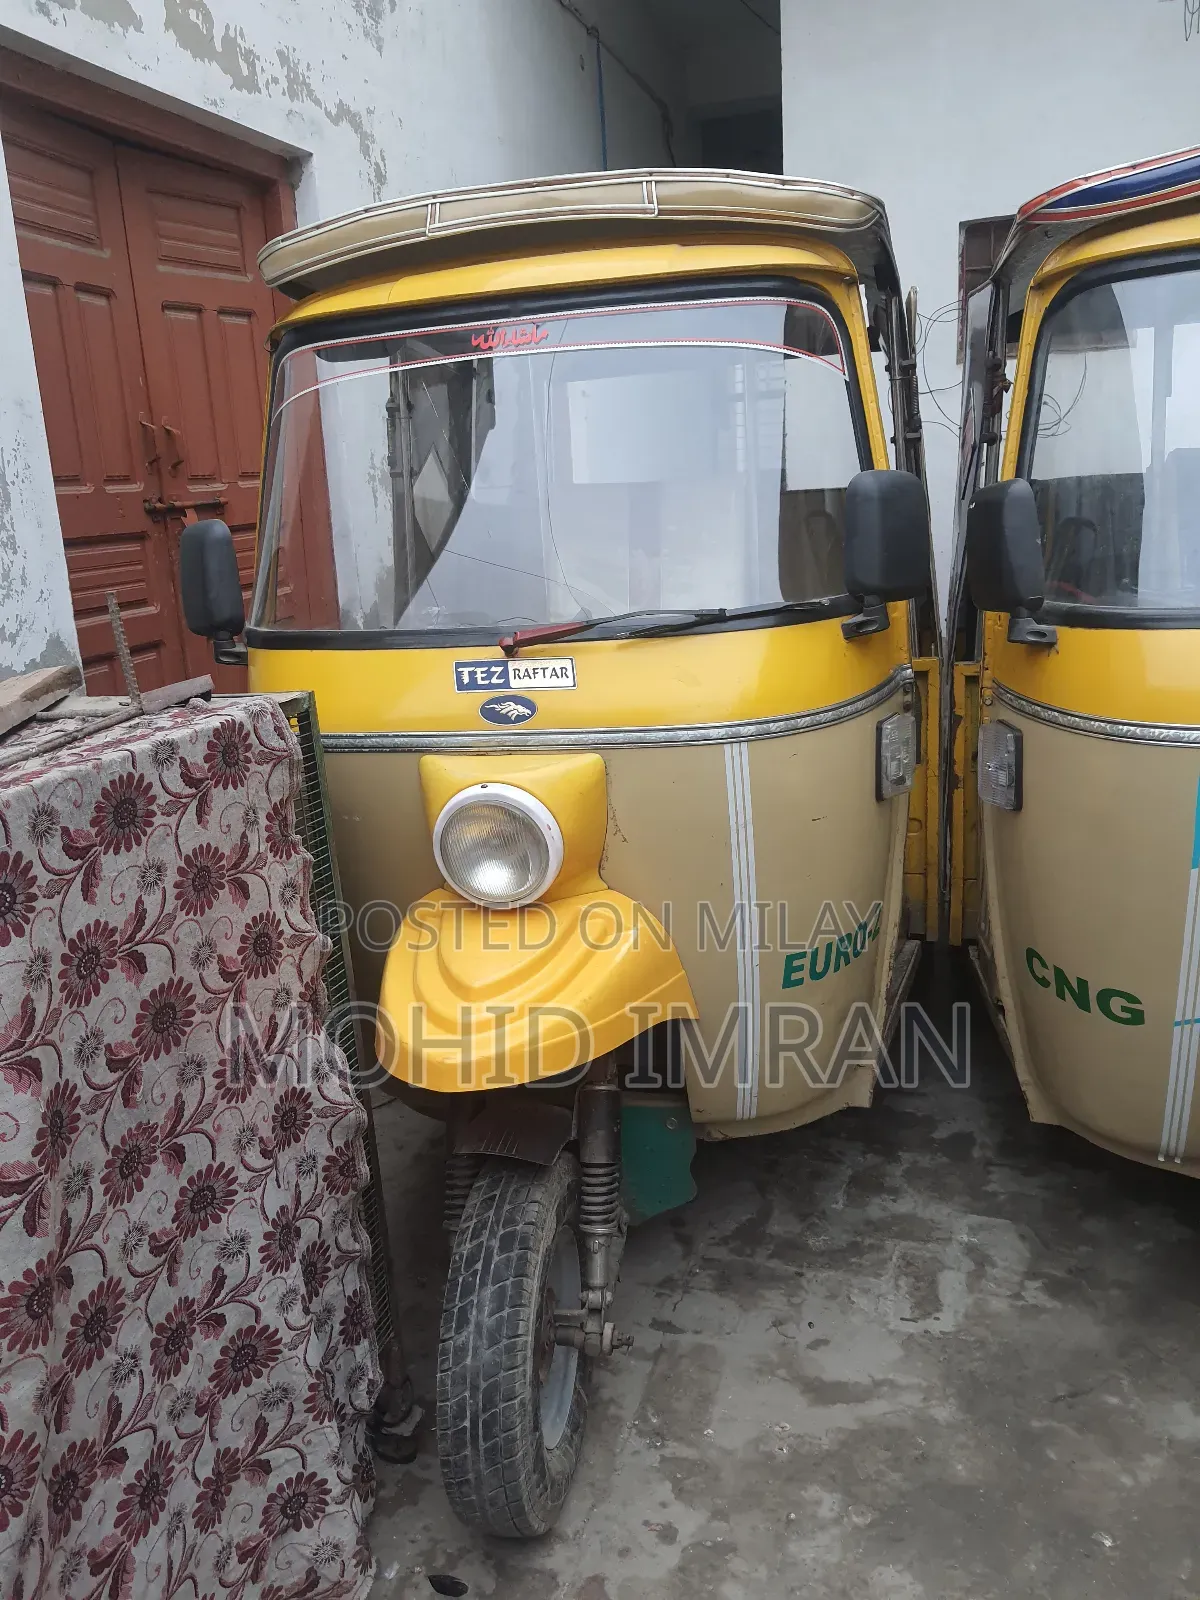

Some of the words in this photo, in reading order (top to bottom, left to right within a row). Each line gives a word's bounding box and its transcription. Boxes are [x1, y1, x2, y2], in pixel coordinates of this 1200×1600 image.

[457, 665, 506, 685] TEZ
[513, 666, 570, 680] RAFTAR
[1026, 947, 1146, 1026] CNG
